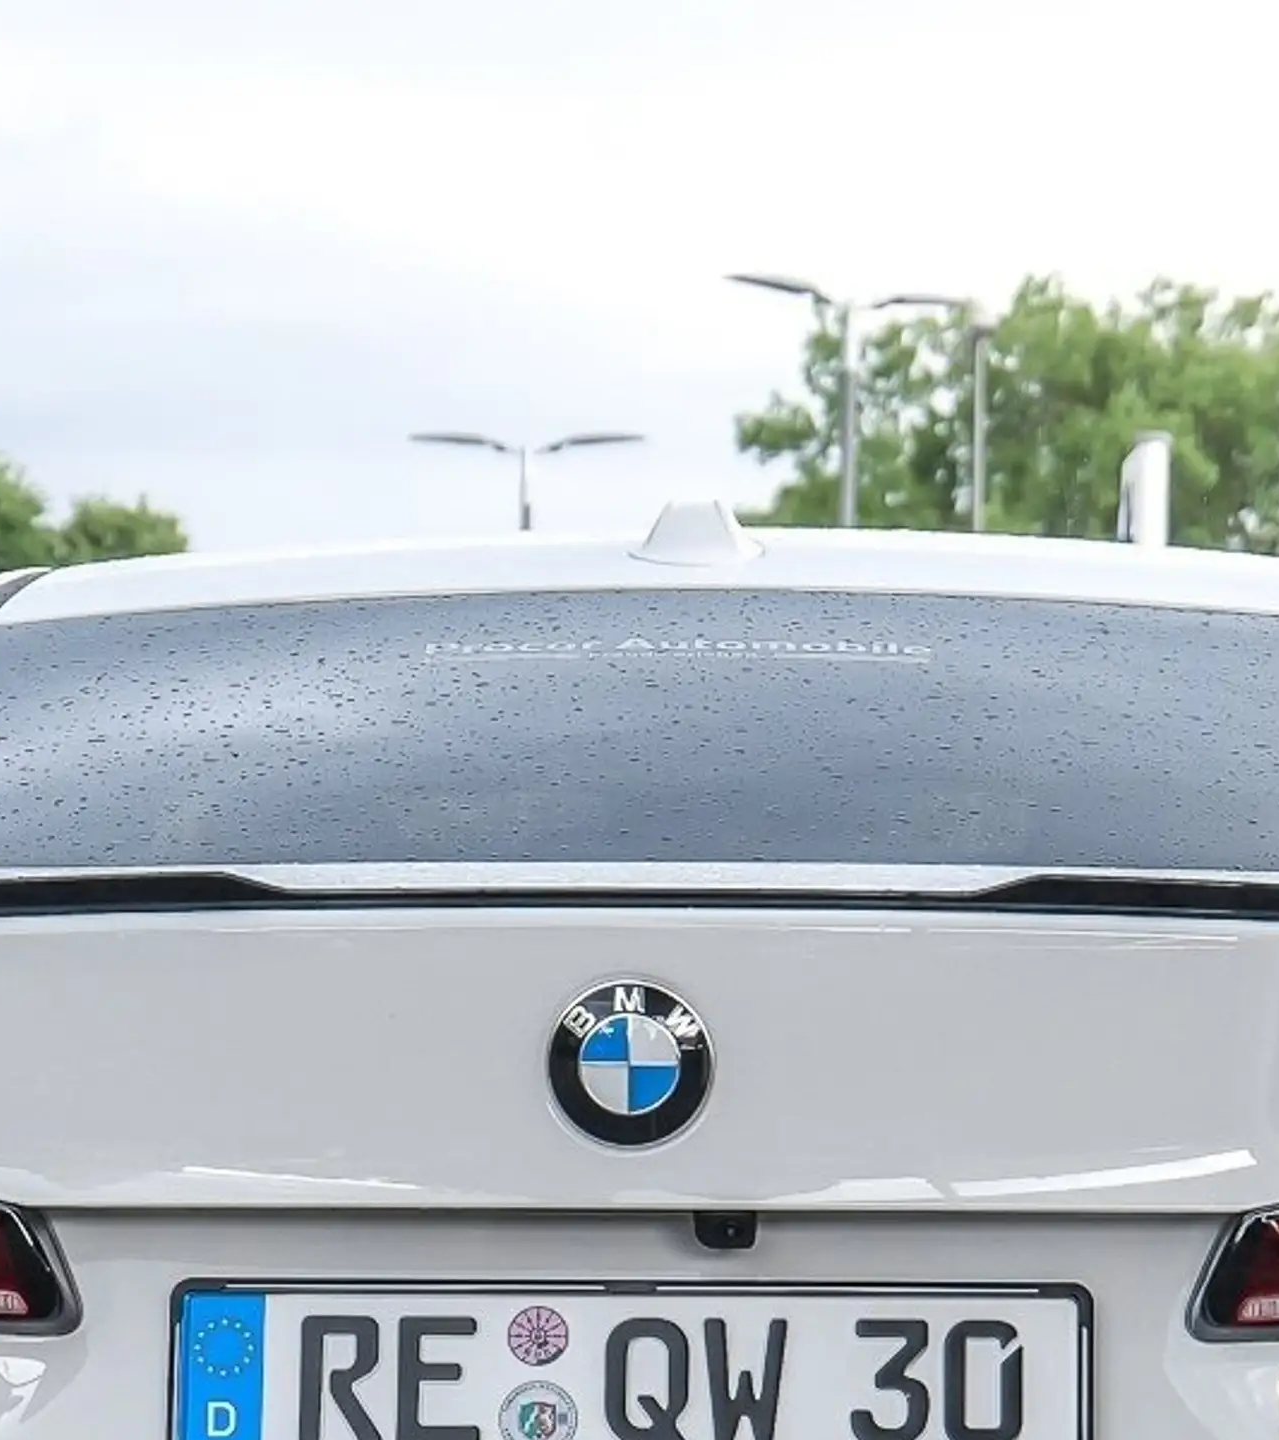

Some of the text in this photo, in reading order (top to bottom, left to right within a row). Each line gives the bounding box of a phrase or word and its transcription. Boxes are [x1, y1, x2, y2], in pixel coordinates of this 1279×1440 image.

[615, 637, 931, 655] Automobile
[563, 986, 703, 1039] BMW
[207, 1401, 236, 1437] D
